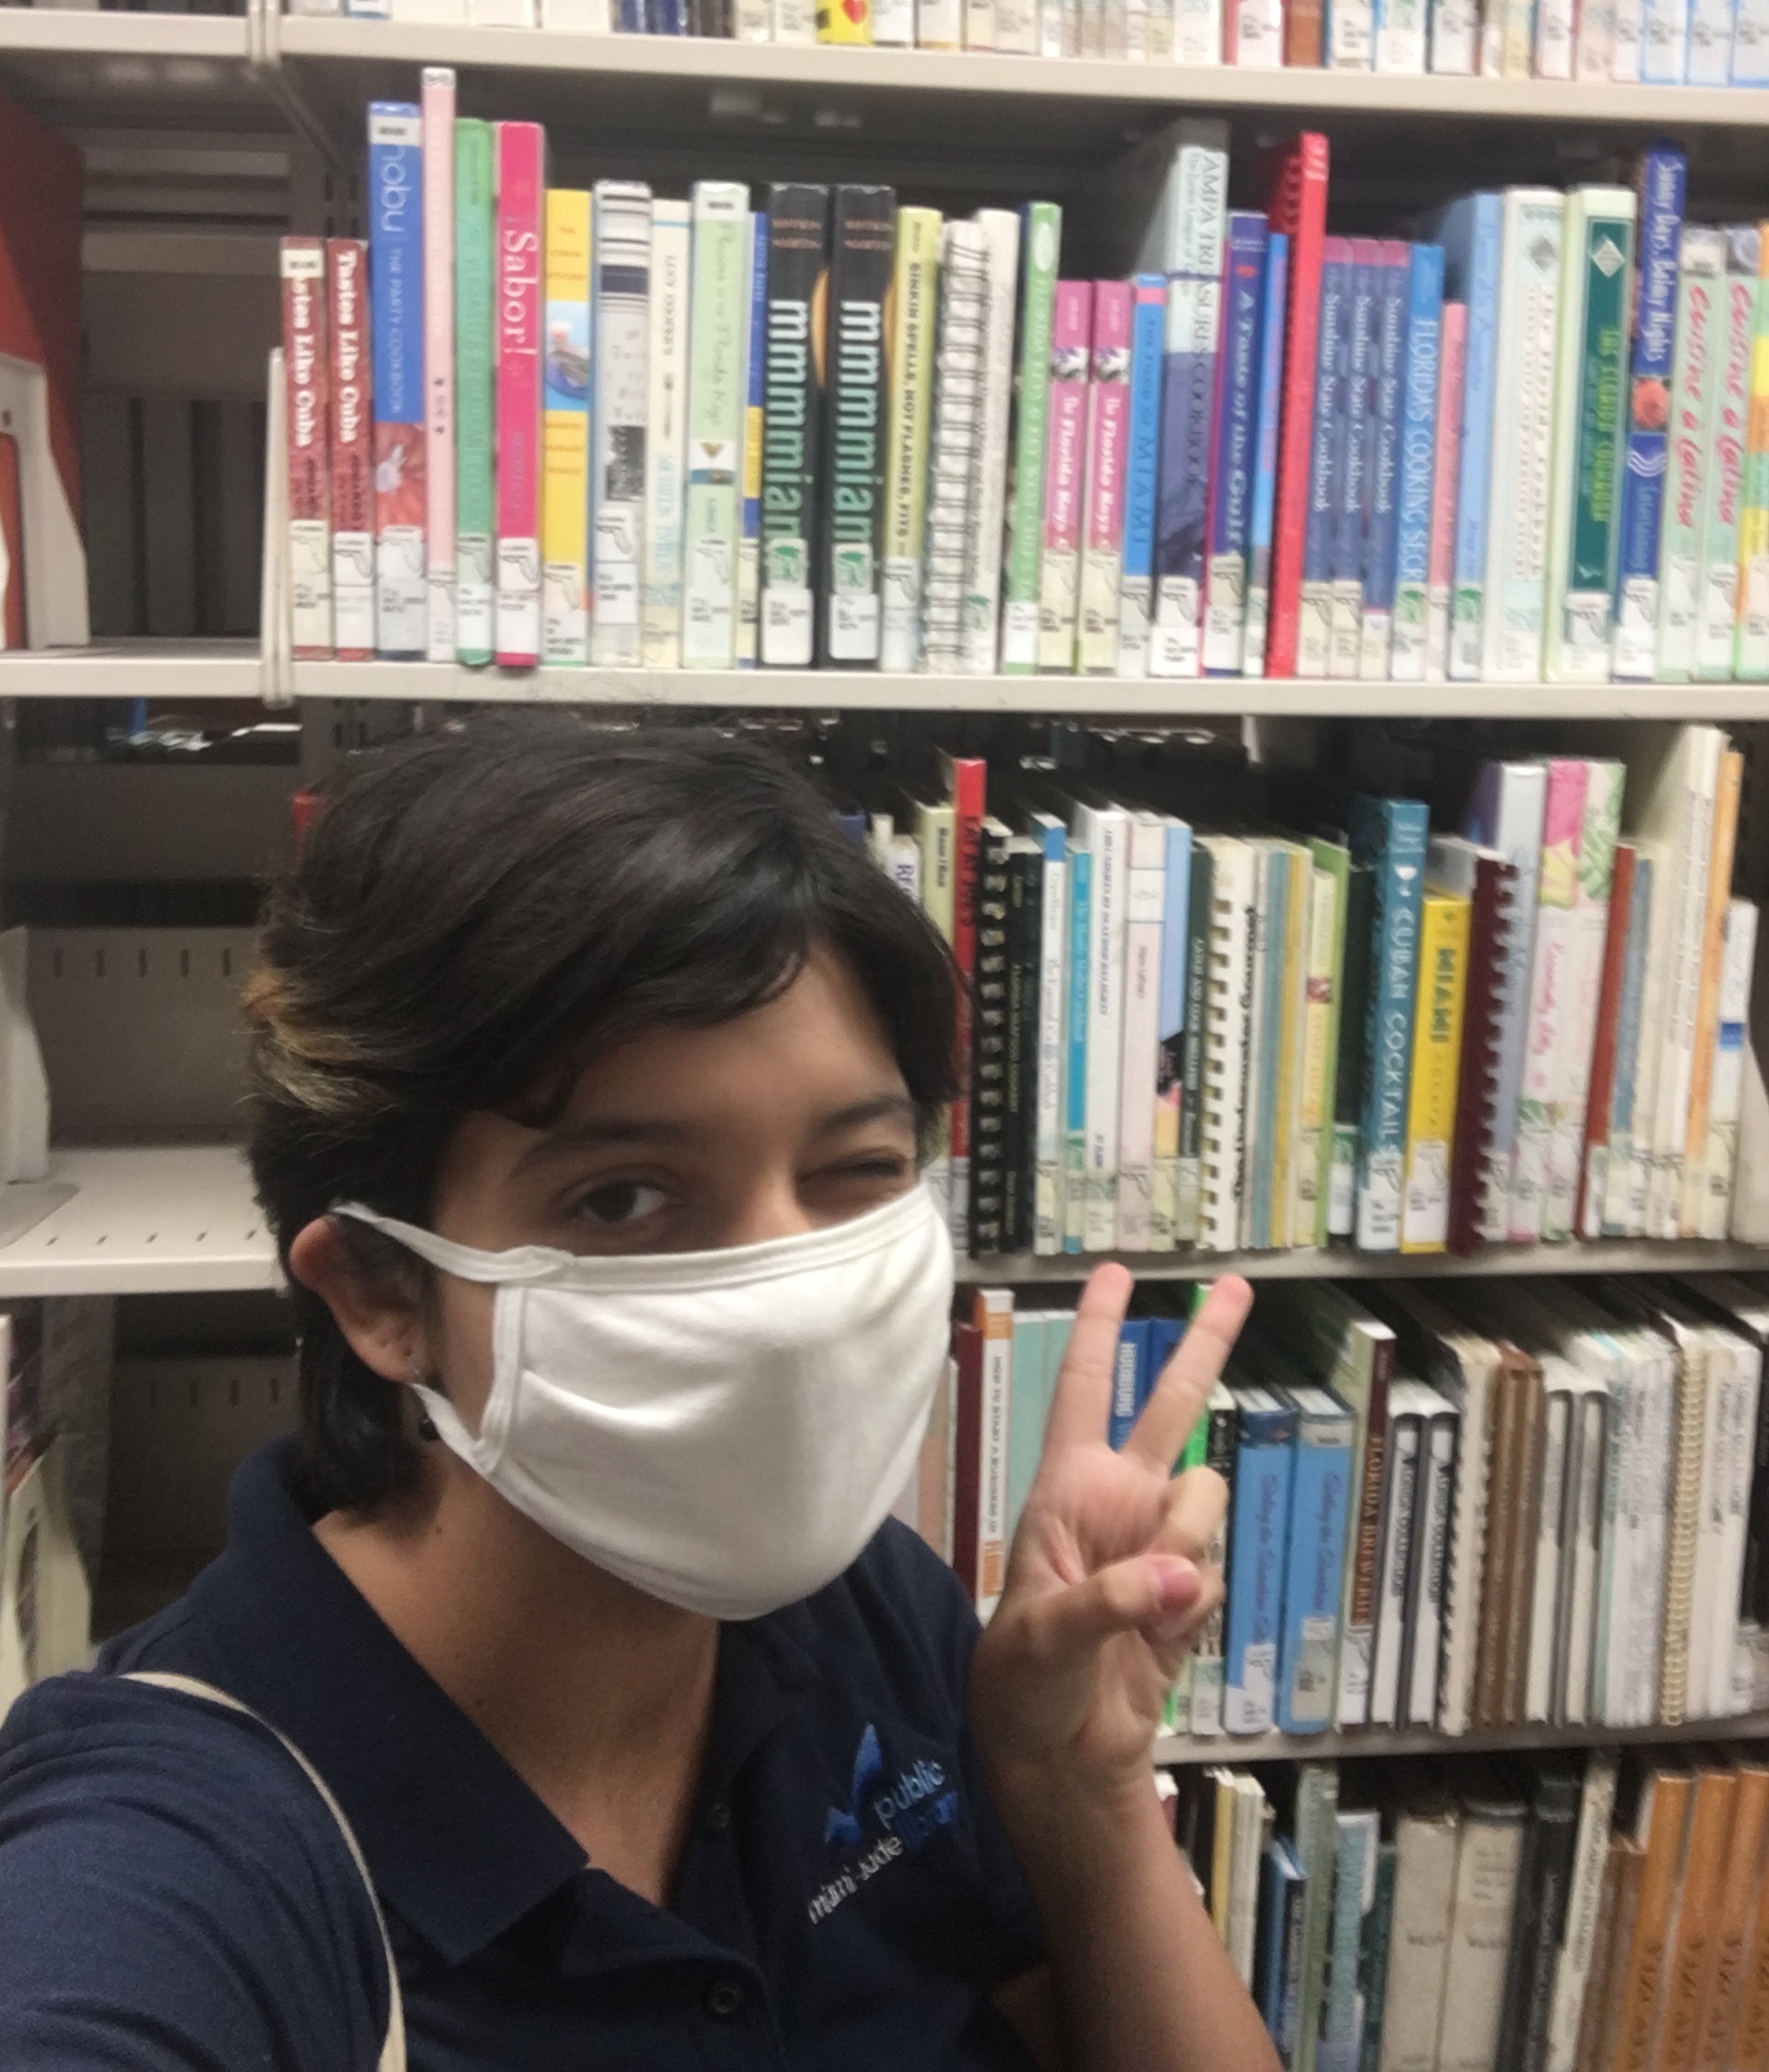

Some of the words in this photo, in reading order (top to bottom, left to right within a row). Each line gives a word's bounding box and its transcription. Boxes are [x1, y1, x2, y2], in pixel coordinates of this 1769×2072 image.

[379, 145, 412, 232] nobu
[1655, 160, 1685, 211] Sunny
[335, 250, 360, 326] Tastes
[387, 279, 405, 323] PARTY
[1238, 290, 1256, 312] A
[293, 334, 316, 386] Like
[336, 328, 361, 381] Like
[1235, 319, 1255, 386] Taste
[1643, 311, 1672, 363] Nights
[294, 389, 318, 447] Cuba
[337, 385, 361, 444] Cuba
[1231, 391, 1250, 420] of
[1058, 418, 1078, 486] Florida
[1098, 419, 1118, 487] Florida
[1231, 423, 1251, 465] the
[1133, 434, 1157, 547] MIAMI
[1402, 427, 1434, 524] COOKING
[897, 503, 911, 537] FITS
[1052, 492, 1073, 533] Keys
[1095, 494, 1115, 534] Keys
[1225, 469, 1249, 549] Gulf
[1400, 530, 1428, 582] SECR
[1388, 906, 1417, 999] CUBAN
[1429, 947, 1458, 1044] MIAMI
[1362, 1435, 1385, 1518] FLORIDA
[873, 1758, 946, 1831] public
